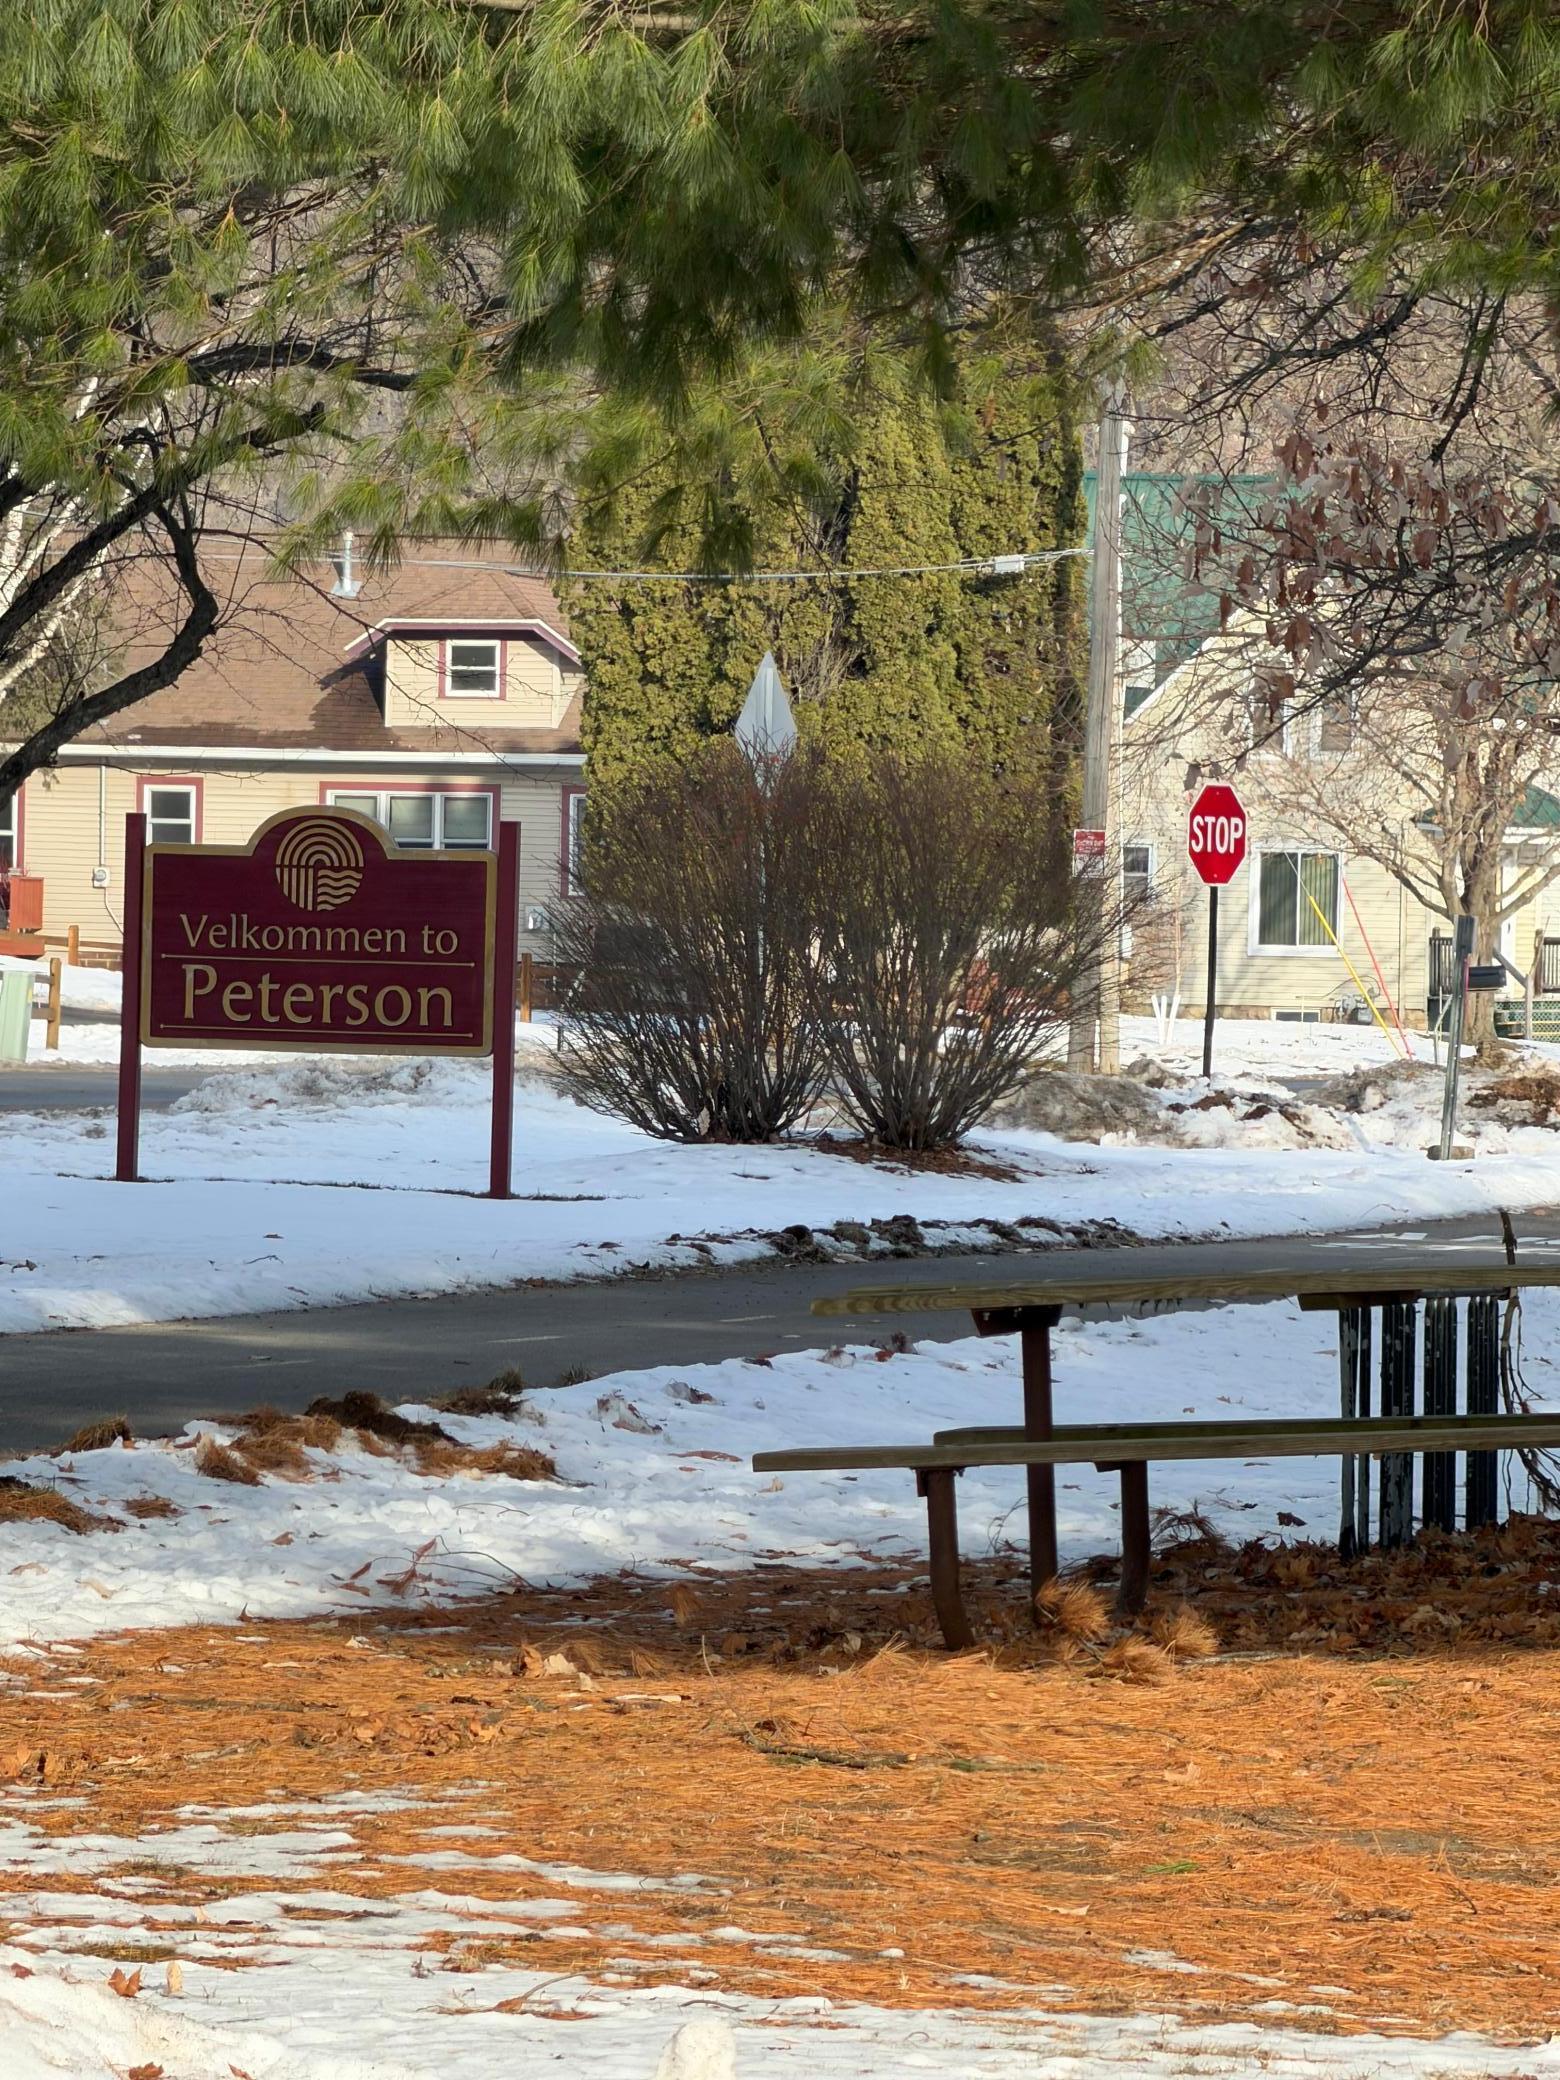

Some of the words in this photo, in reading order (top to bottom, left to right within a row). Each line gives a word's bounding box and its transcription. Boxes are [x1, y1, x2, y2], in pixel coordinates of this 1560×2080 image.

[1191, 815, 1243, 854] STOP
[179, 914, 406, 953] Velkommen
[421, 925, 458, 955] to
[181, 964, 454, 1027] Peterson
